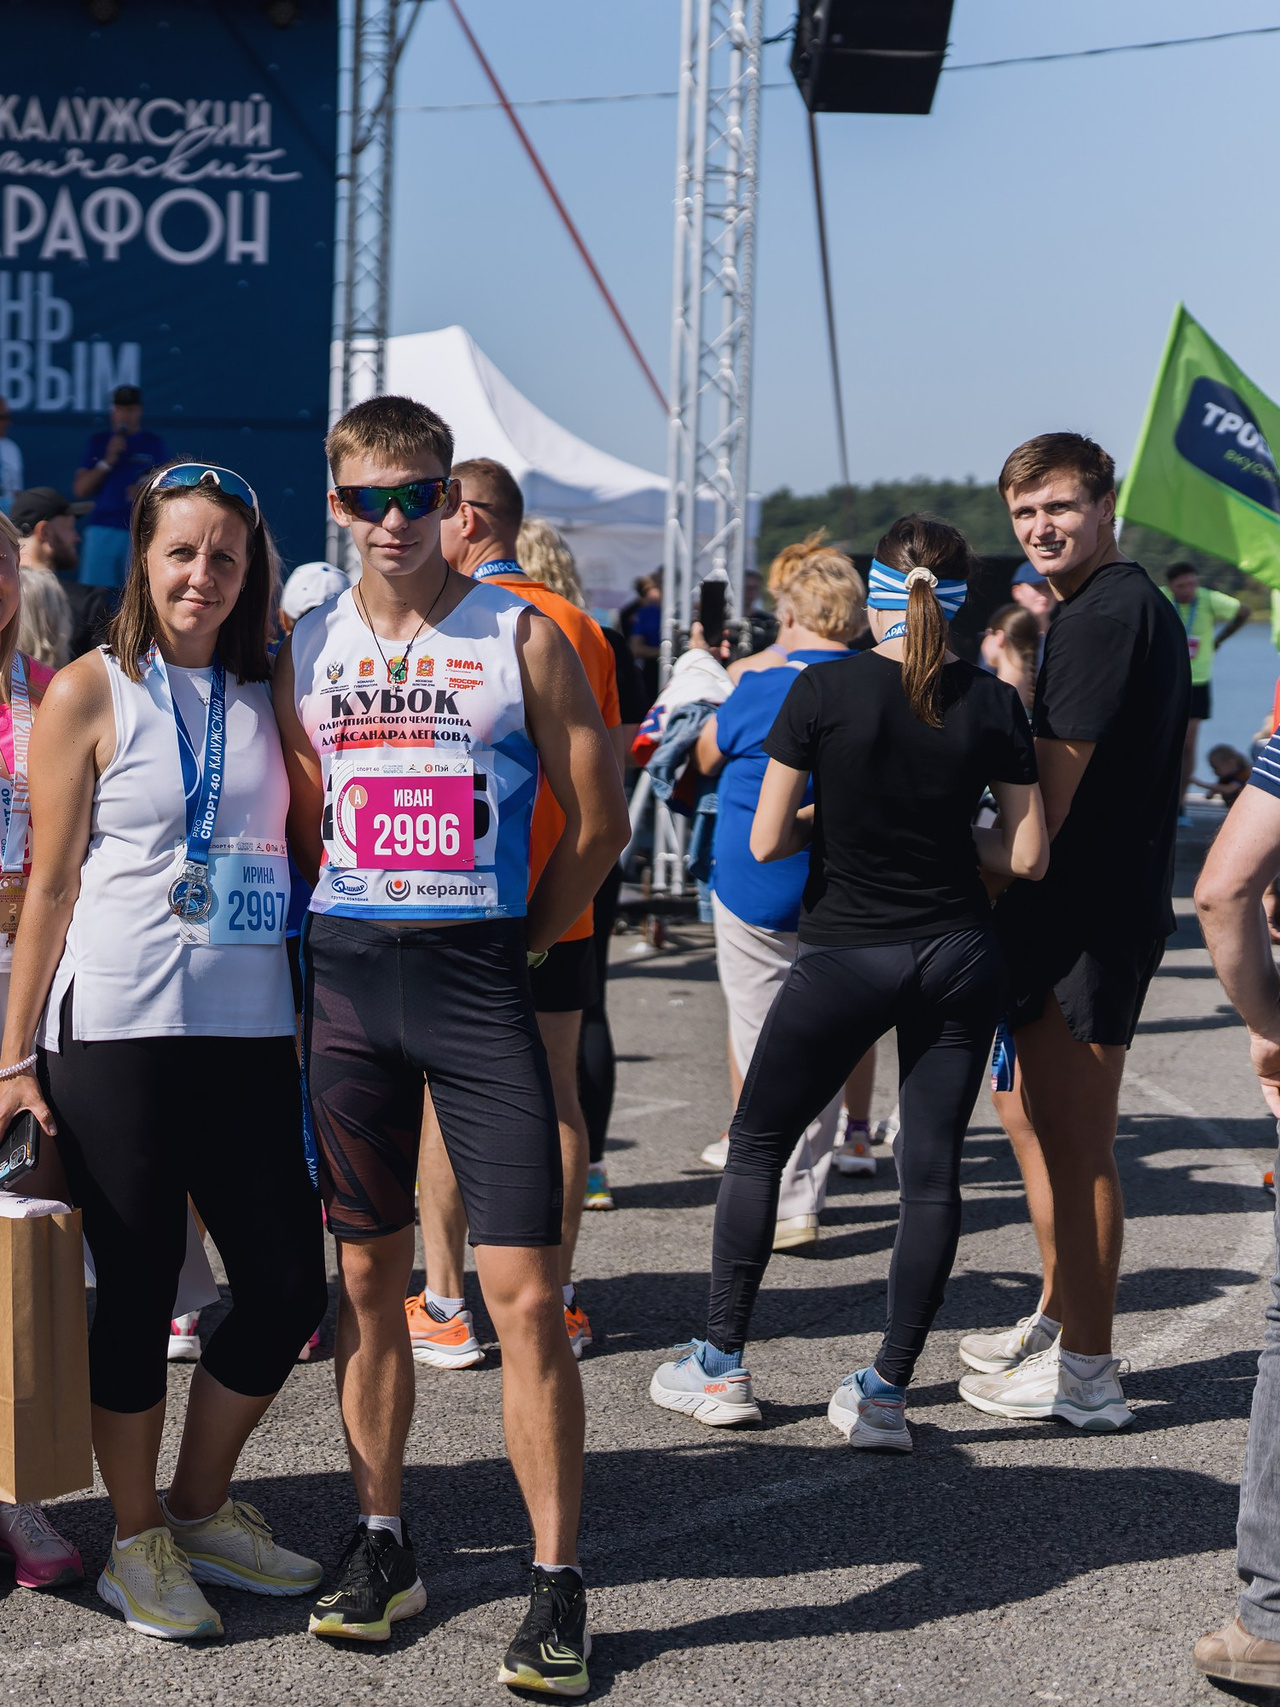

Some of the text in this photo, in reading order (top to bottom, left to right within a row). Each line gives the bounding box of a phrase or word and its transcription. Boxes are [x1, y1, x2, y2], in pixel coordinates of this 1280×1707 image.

[446, 658, 484, 671] ЗИМА
[448, 682, 476, 690] СПОРТ
[449, 677, 484, 686] МОСОБЛ
[331, 688, 460, 718] КУБОК
[319, 715, 472, 731] ОЛИМПИЙСКОГО ЧЕМПИОНА
[208, 697, 224, 770] КАЛУЖСКИЙ
[321, 729, 472, 747] АЛЕКСАНДРА ЛЕГКОВА
[434, 764, 449, 773] Пэй
[210, 773, 221, 791] 40
[354, 789, 362, 805] А
[393, 788, 433, 807] ИВАН
[200, 791, 218, 840] СПОРТ
[192, 819, 202, 838] PRO
[373, 813, 460, 856] 2996
[243, 865, 275, 884] ИРИНА
[416, 883, 487, 898] кералит
[227, 890, 286, 931] 2997
[704, 1382, 728, 1394] HOKA
